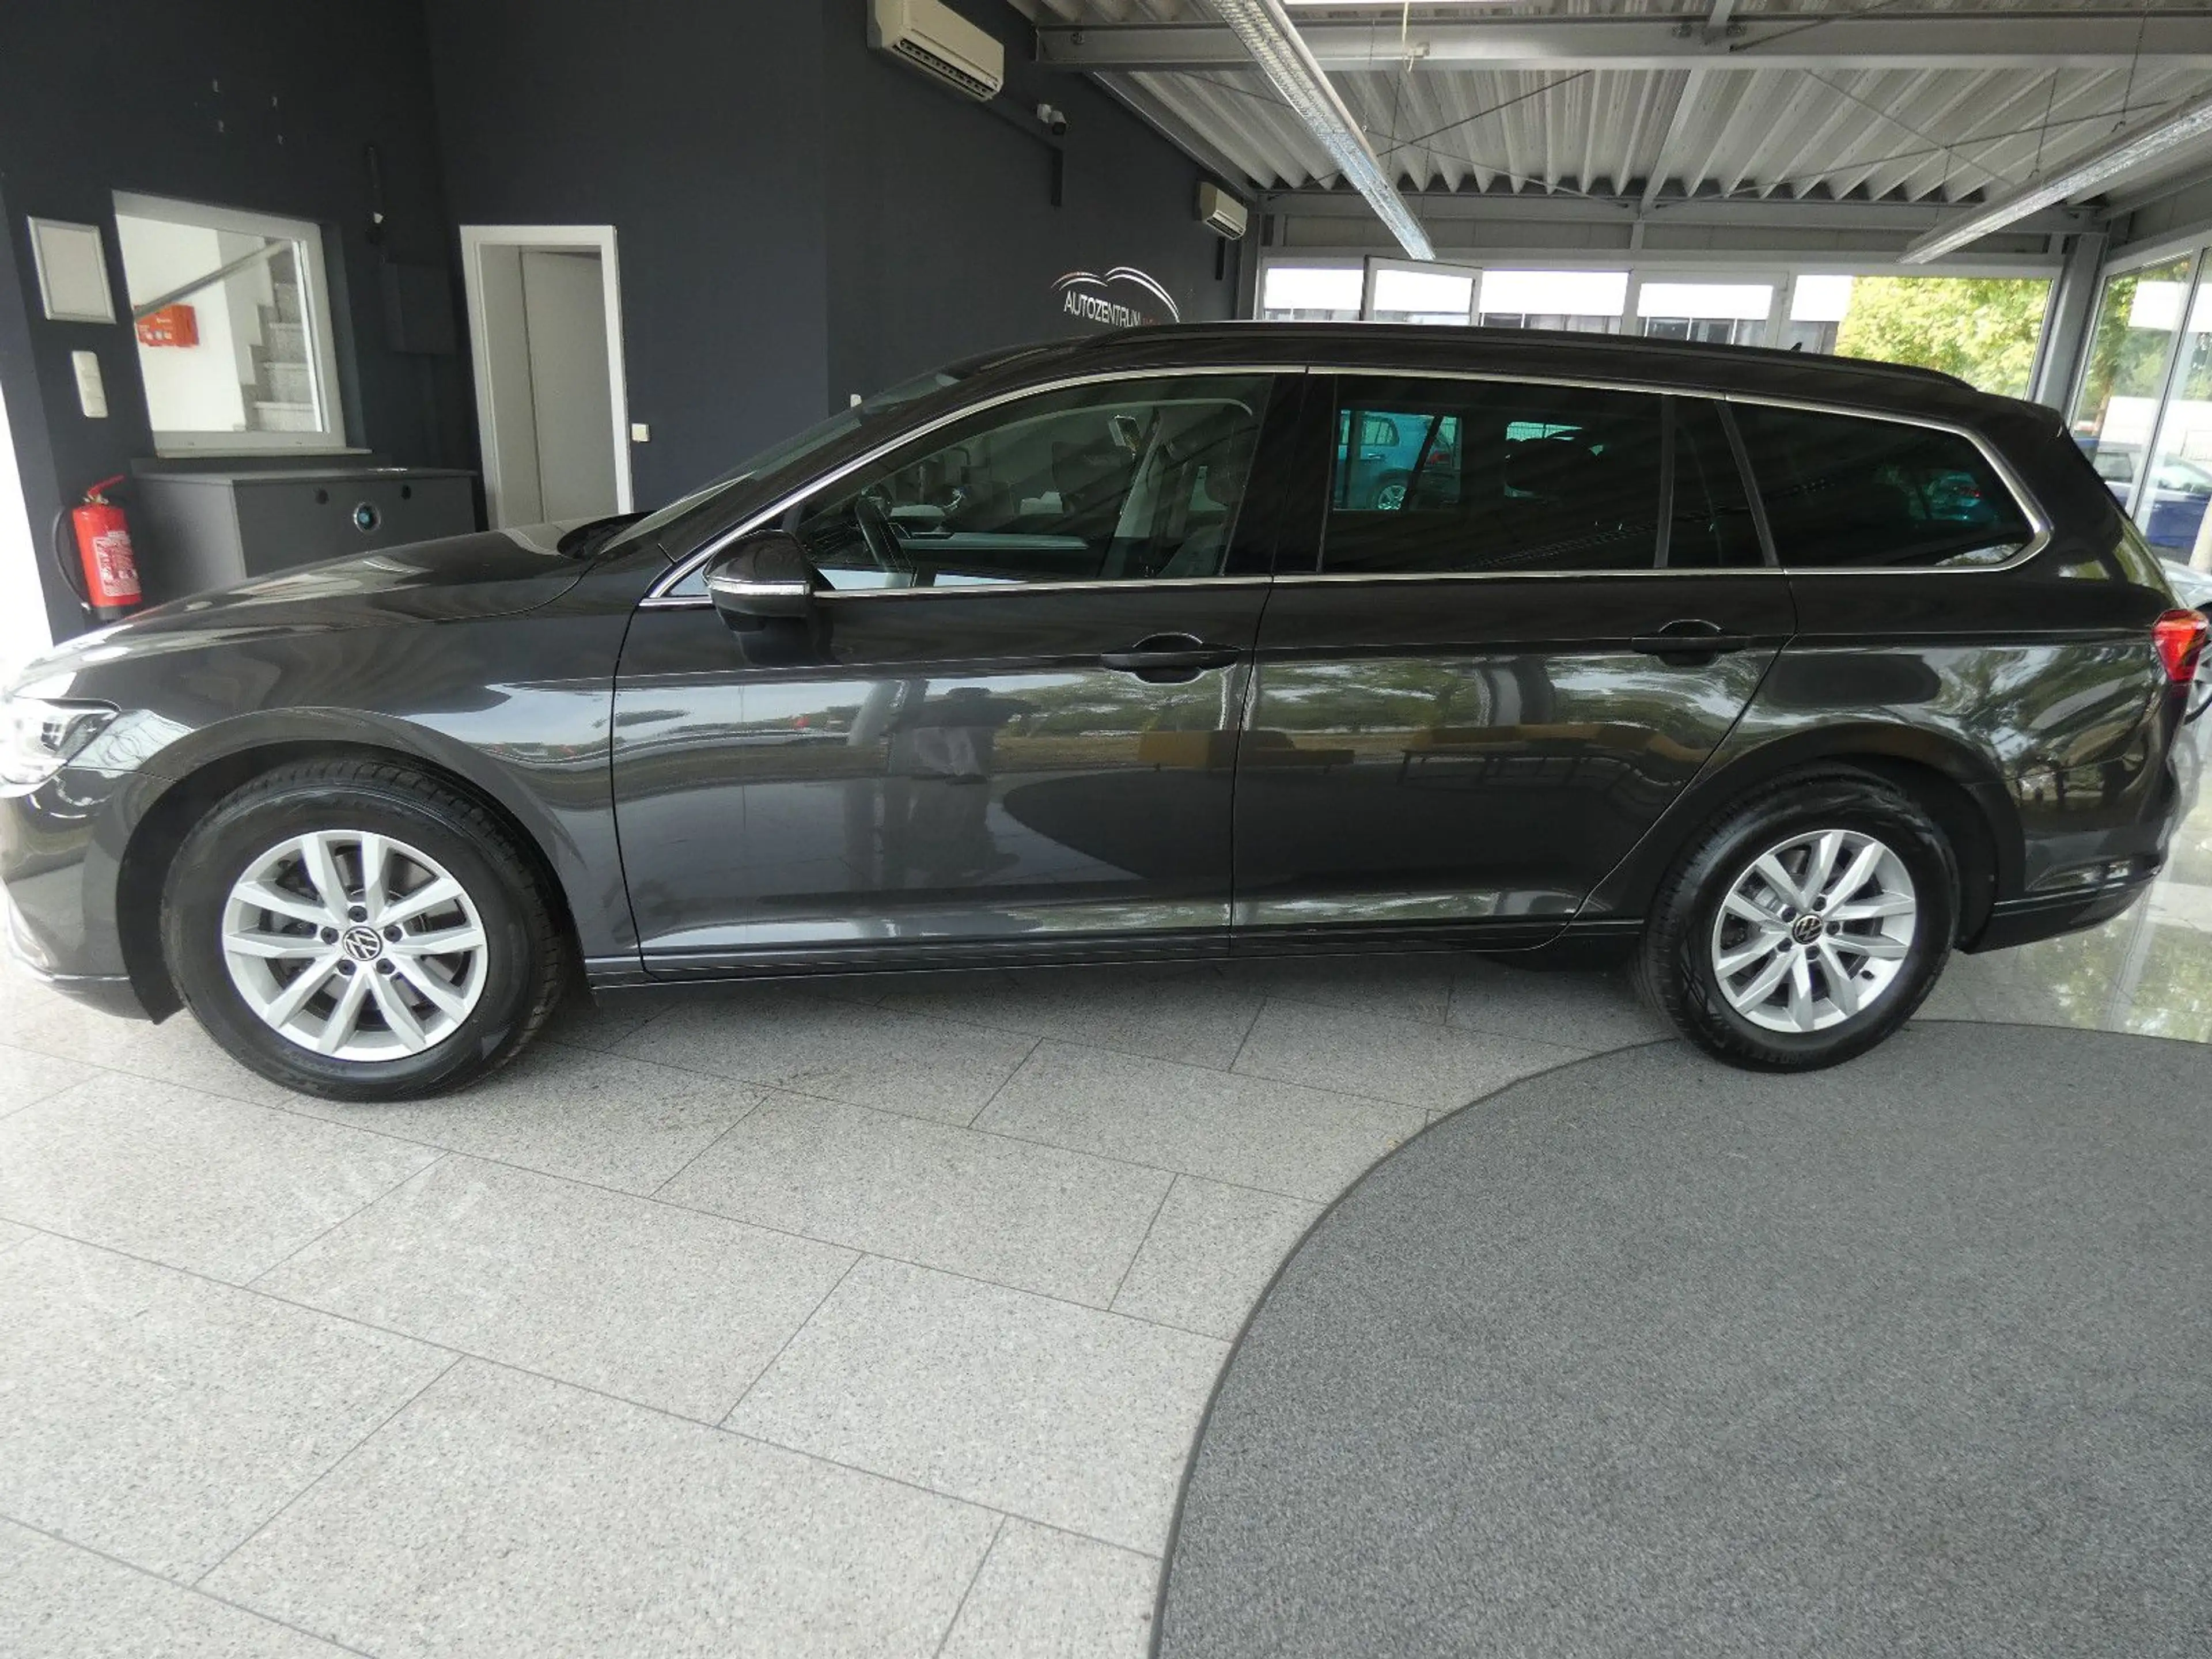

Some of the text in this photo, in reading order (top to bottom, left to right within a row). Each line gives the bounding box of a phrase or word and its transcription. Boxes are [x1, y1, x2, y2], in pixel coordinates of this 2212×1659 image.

[1064, 290, 1141, 328] AUTOZENTRUM
[344, 927, 381, 960] VW
[1794, 915, 1823, 944] VW
